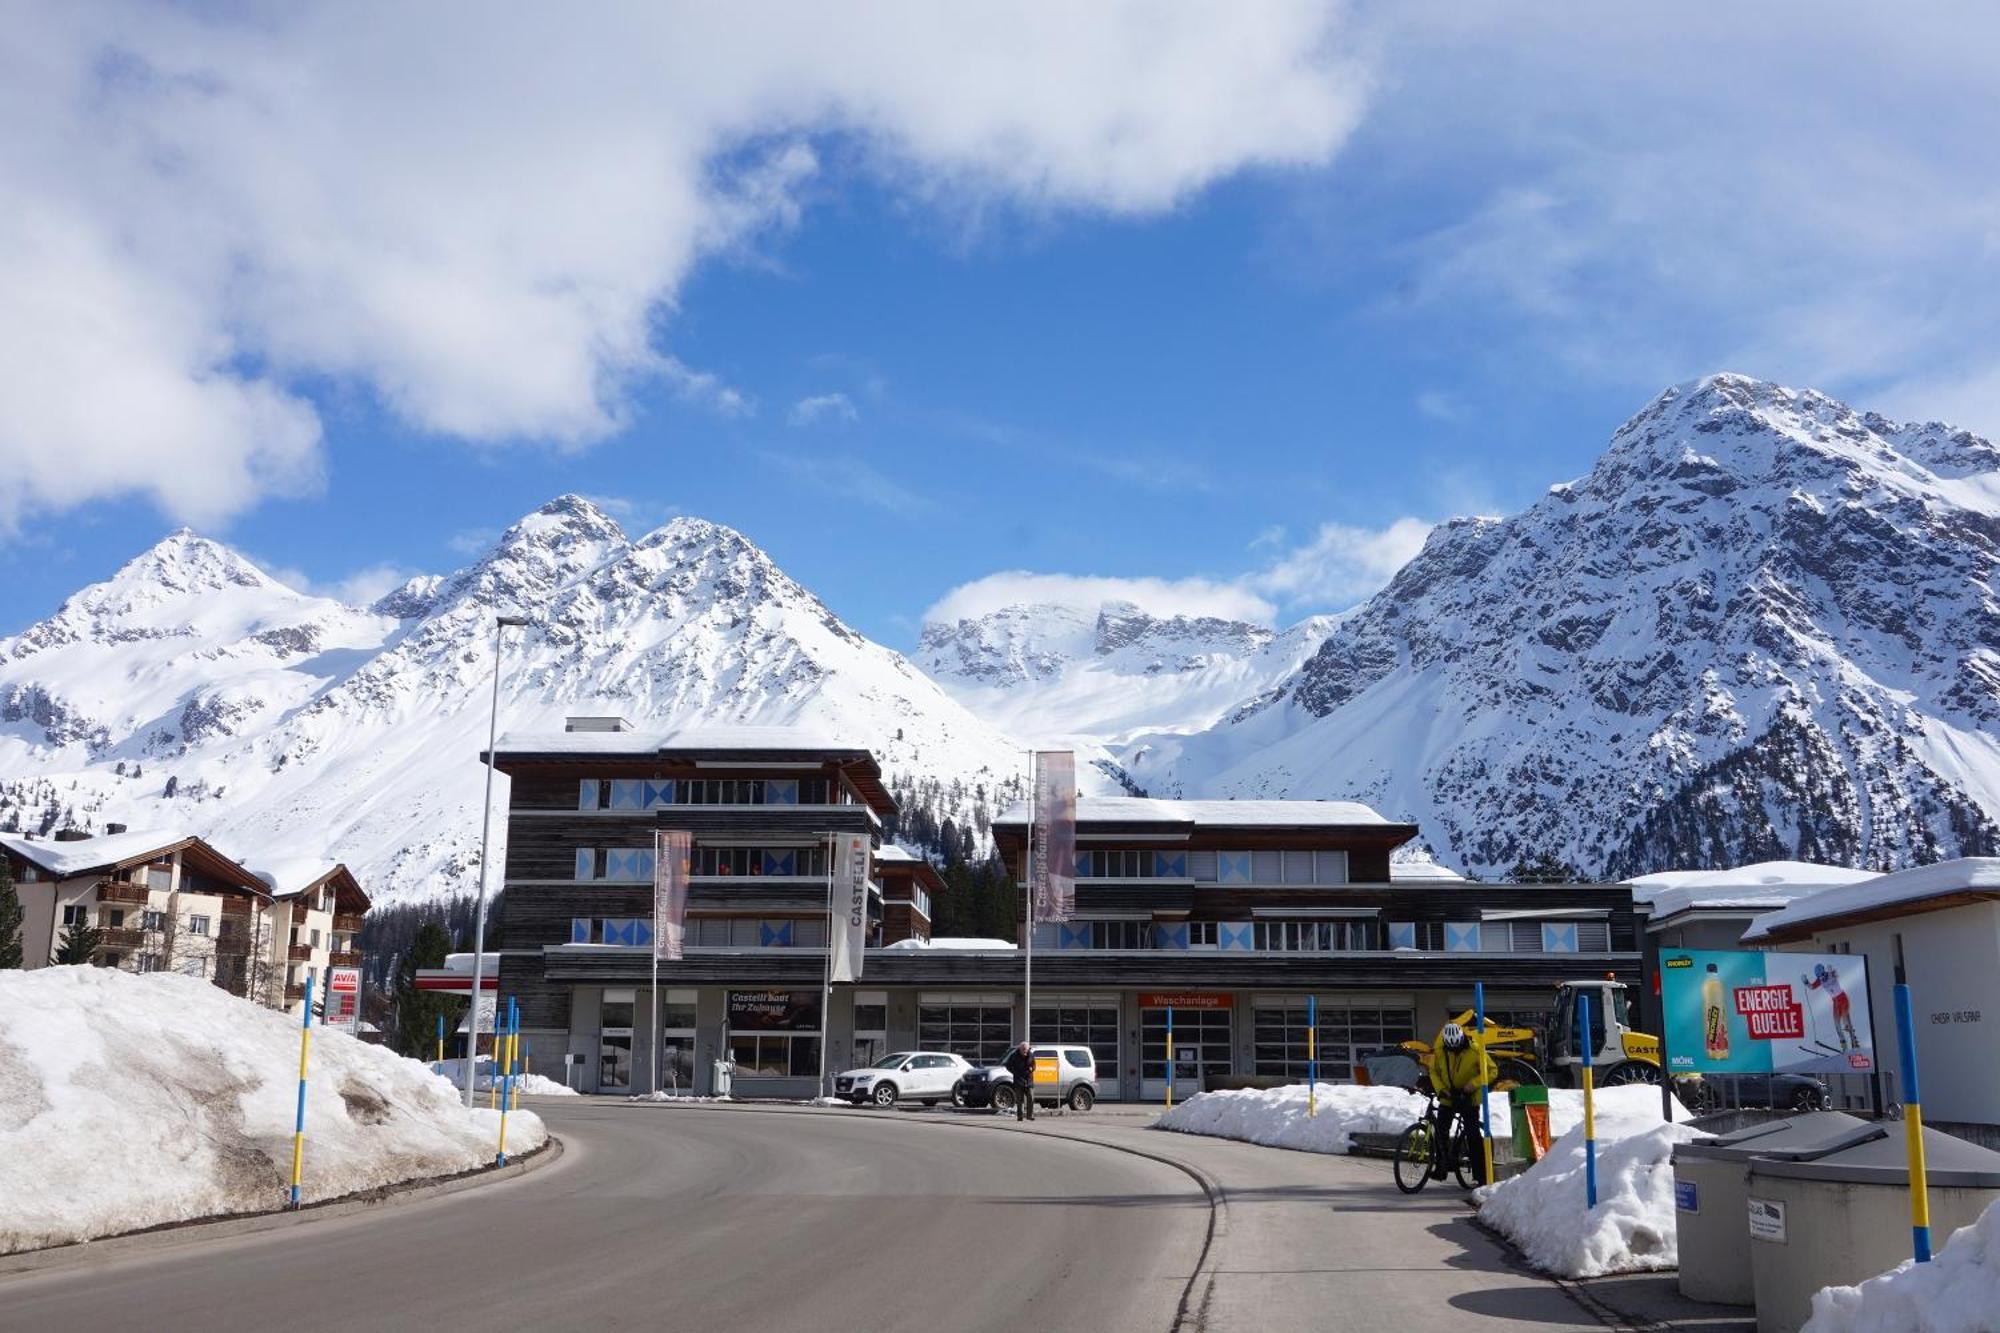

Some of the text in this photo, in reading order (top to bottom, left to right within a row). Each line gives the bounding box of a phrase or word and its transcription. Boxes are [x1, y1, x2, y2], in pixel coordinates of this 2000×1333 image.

[1037, 831, 1048, 859] baut
[851, 852, 864, 927] CASTELLI
[1036, 861, 1048, 908] Castelli
[732, 993, 790, 1002] Castelli baut
[732, 1003, 746, 1011] Ihr
[1153, 995, 1219, 1008] Waschanlage
[1738, 989, 1790, 1011] ENERGIE
[1751, 1012, 1799, 1034] QUELLE
[1672, 1055, 1694, 1065] MÖHL
